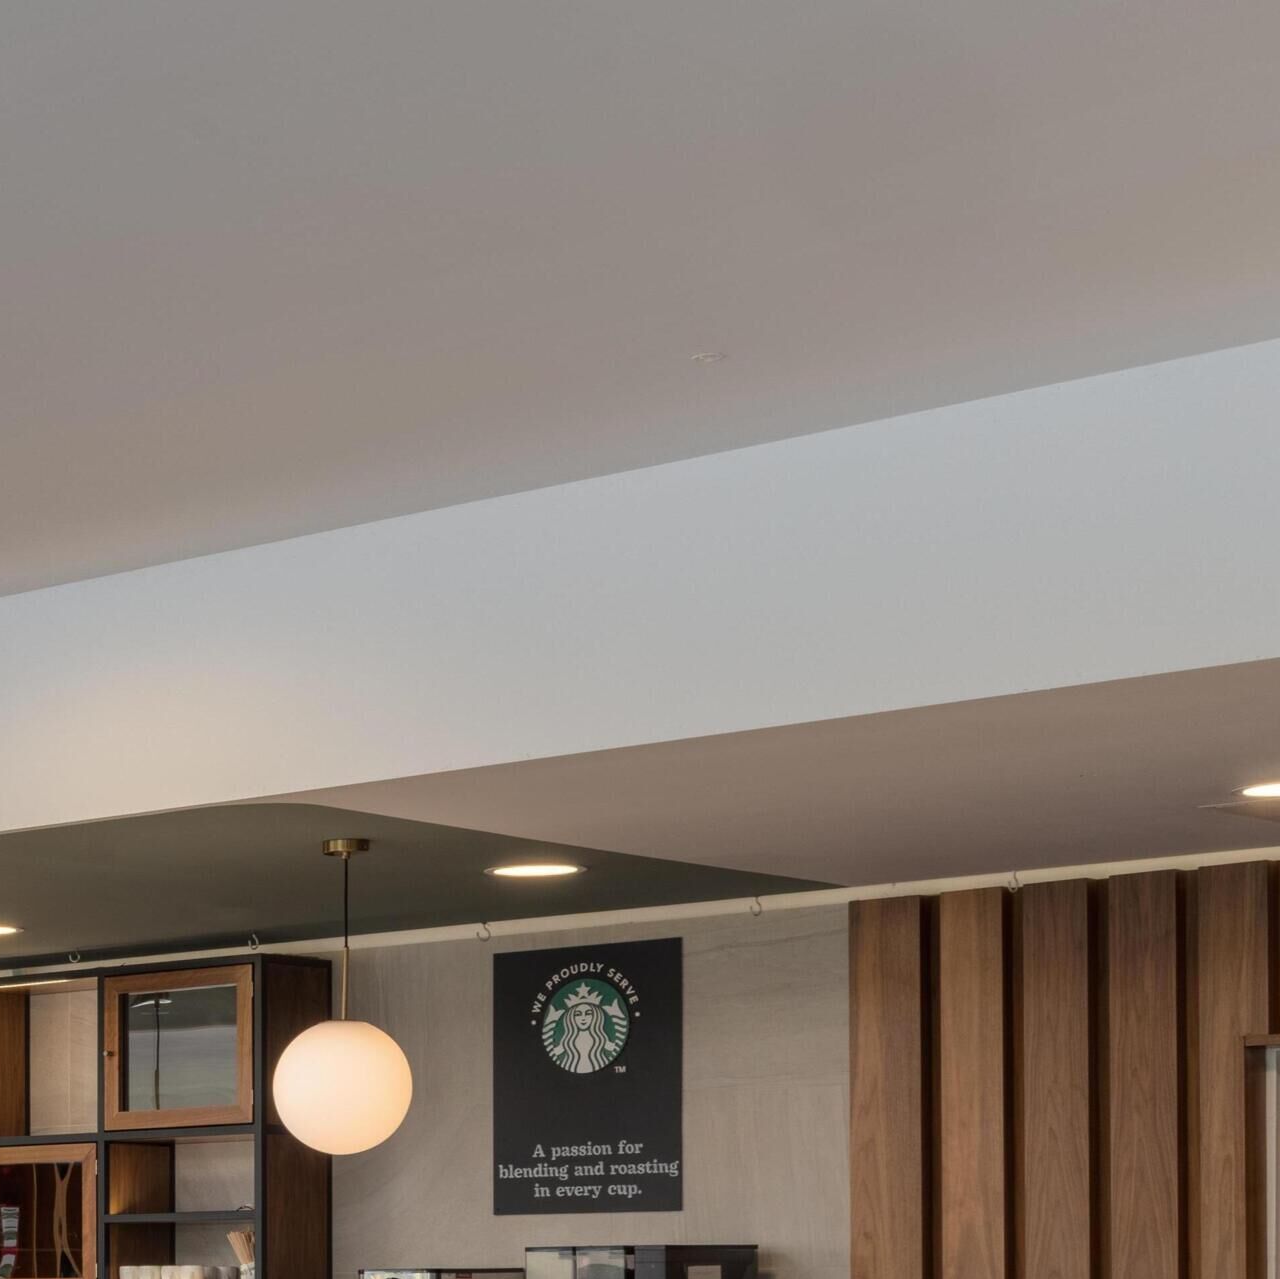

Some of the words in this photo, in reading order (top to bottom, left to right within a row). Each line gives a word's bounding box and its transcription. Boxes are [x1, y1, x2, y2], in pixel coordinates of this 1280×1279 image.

[531, 992, 547, 1013] WE
[545, 962, 604, 990] PROUDLY
[607, 968, 640, 1004] SERVE
[532, 1144, 546, 1158] A
[551, 1141, 612, 1160] passion
[617, 1140, 643, 1154] for
[498, 1163, 569, 1180] blending
[574, 1161, 605, 1176] and
[609, 1159, 679, 1177] roasting
[534, 1183, 550, 1197] in
[556, 1185, 602, 1198] every
[607, 1184, 642, 1198] cup.
